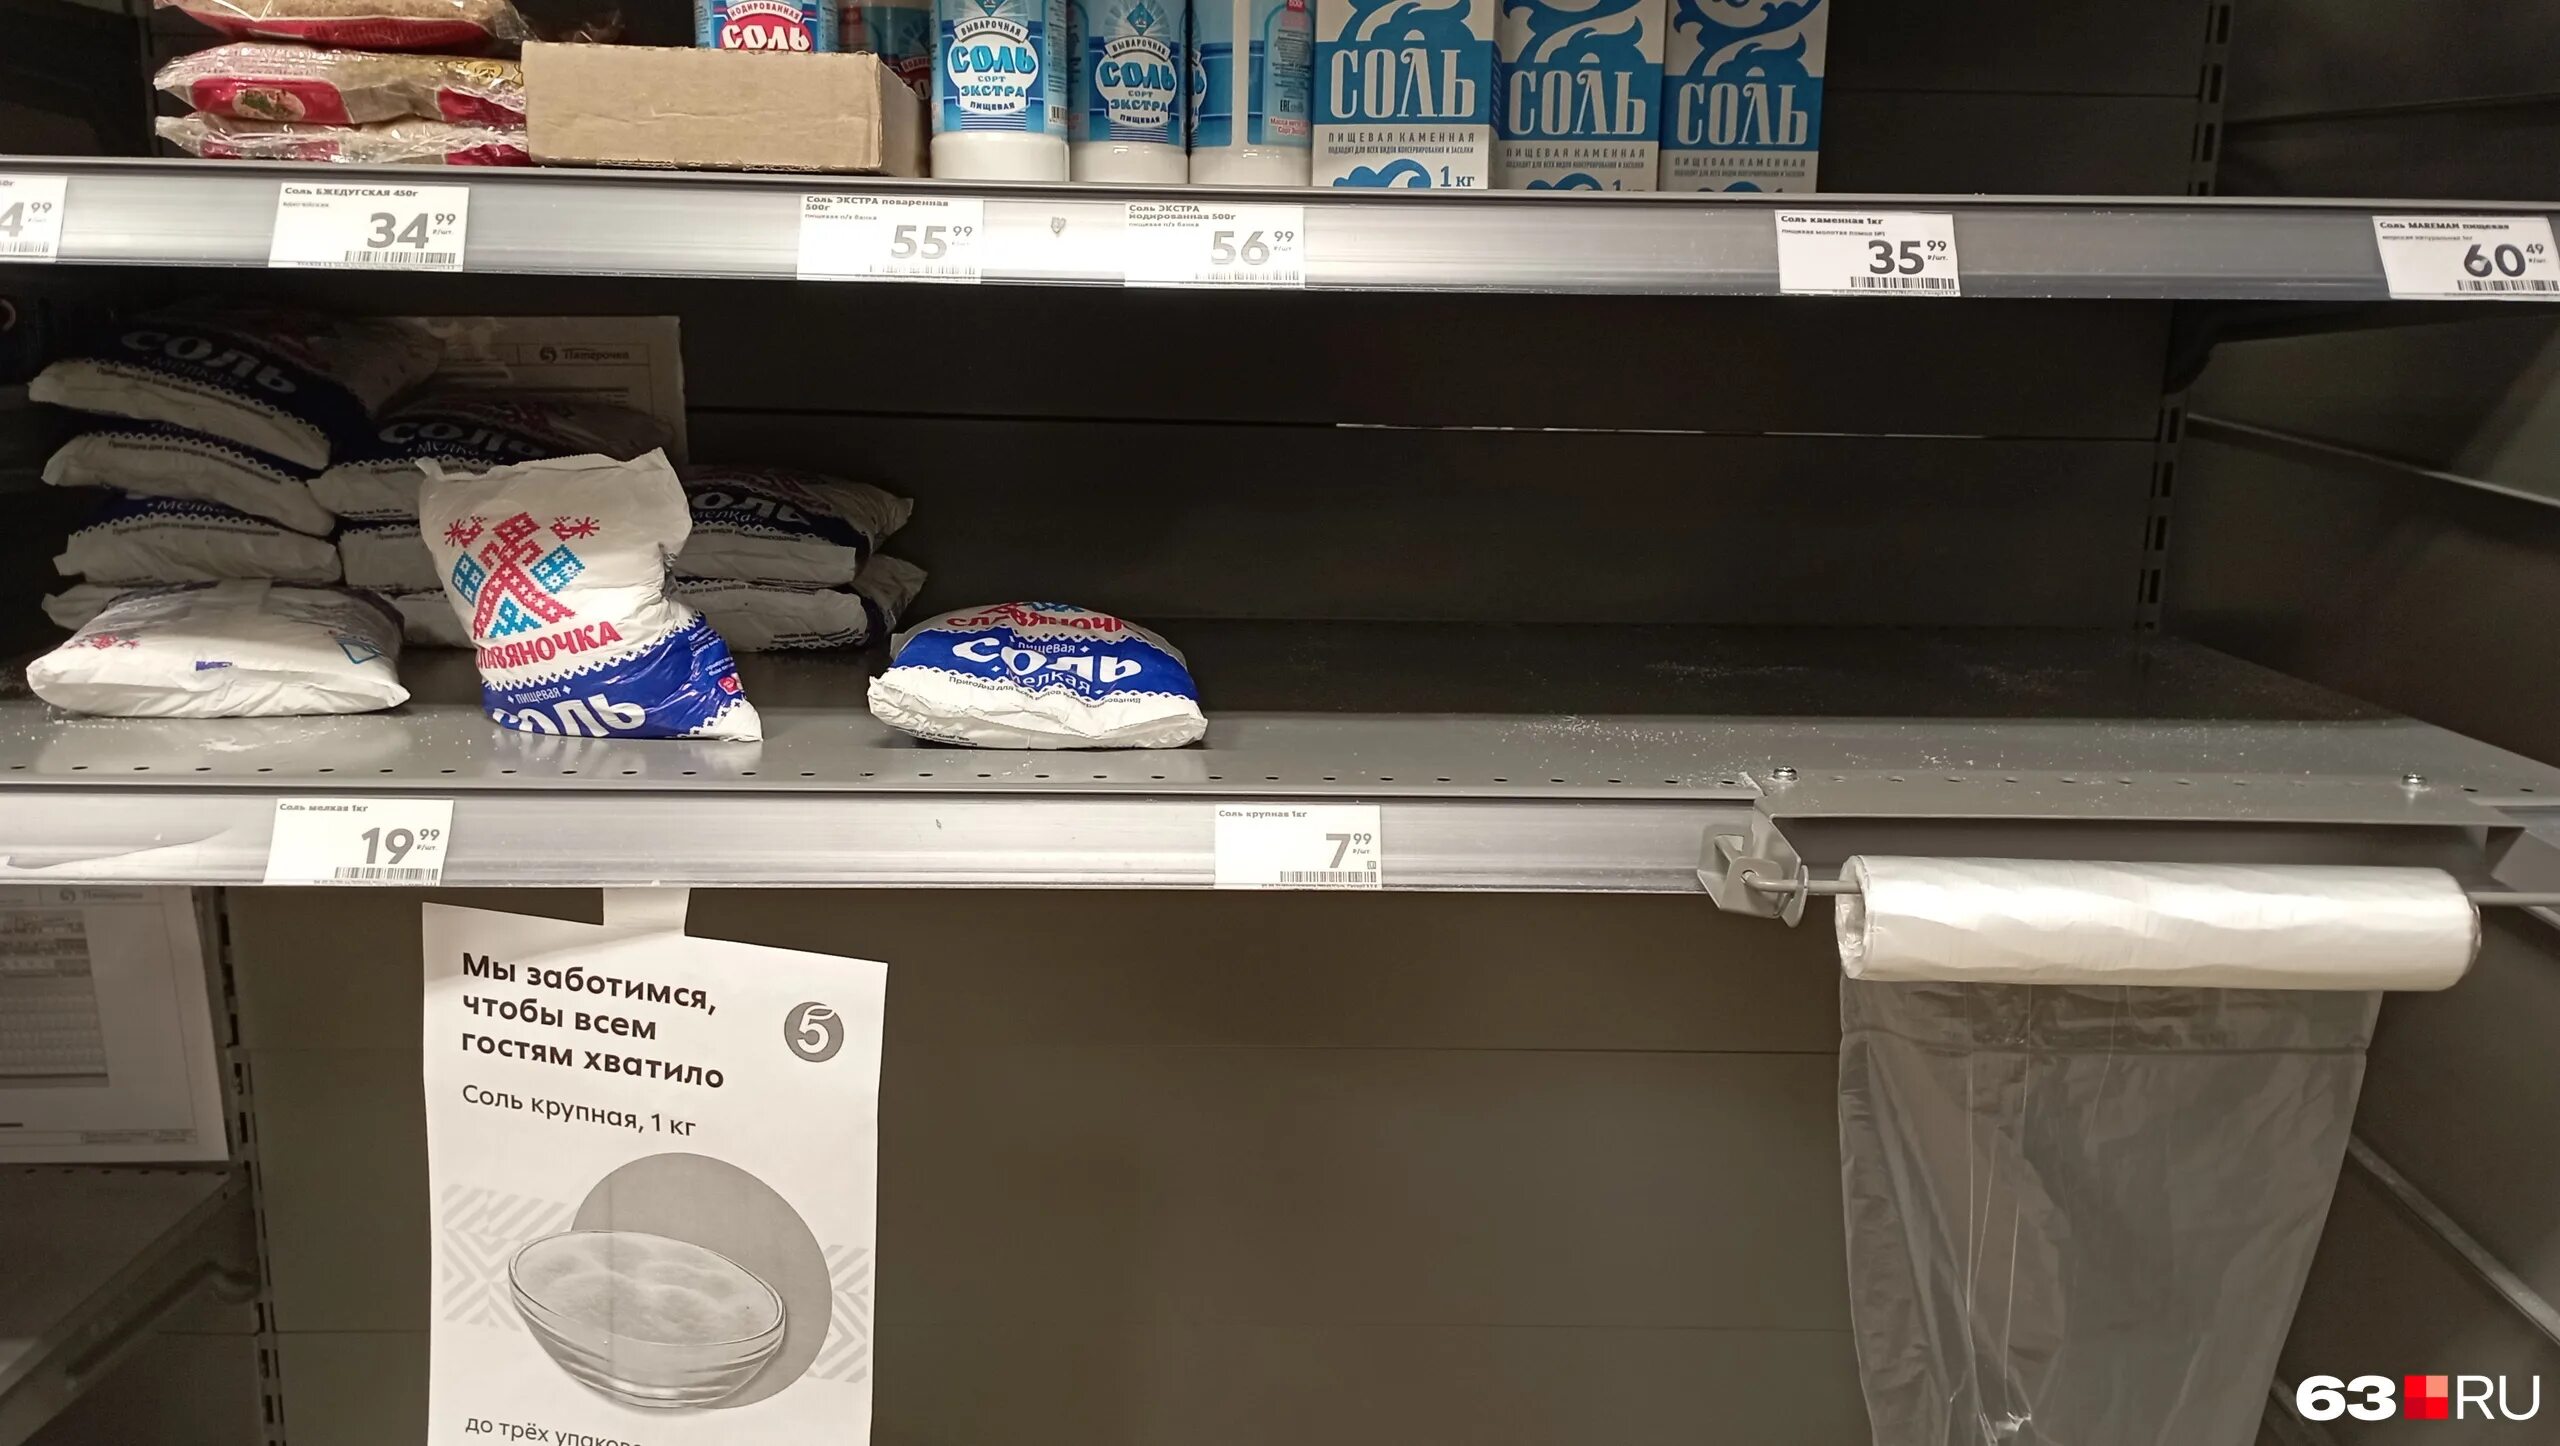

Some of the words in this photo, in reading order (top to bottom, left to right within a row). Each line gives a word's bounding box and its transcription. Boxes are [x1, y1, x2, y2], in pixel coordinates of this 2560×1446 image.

[722, 25, 811, 51] СОЛЬ
[961, 20, 1022, 37] ВЫВАРОЧНАЯ
[1112, 38, 1167, 55] ВЫВАРОЧНАЯ
[951, 45, 1036, 74] СОЛЬ
[1100, 61, 1176, 91] СОЛЬ
[1330, 47, 1476, 119] СОЛЬ
[961, 85, 1025, 97] ЭКСТРА
[1128, 90, 1154, 98] СОРТ
[1508, 69, 1646, 135] СОЛЬ
[970, 101, 1016, 111] ПИЩЕВАЯ
[1110, 99, 1168, 112] ЭКСТРА
[1677, 83, 1808, 145] СОЛЬ
[1119, 114, 1161, 124] ПИЩЕВАЯ
[1328, 132, 1393, 143] ПИЩЕВАЯ
[1400, 132, 1475, 143] КАМЕННАЯ
[1506, 147, 1569, 158] ПИЩЕВАЯ
[1574, 147, 1645, 158] КАМЕННАЯ
[1675, 157, 1734, 168] ПИЩЕВАЯ
[1739, 157, 1806, 168] КАМЕННАЯ
[1440, 165, 1451, 187] 1
[1456, 175, 1475, 187] кг
[284, 187, 312, 195] Соль
[316, 188, 390, 197] БЖЕДУГСКАЯ
[393, 189, 418, 197] 450г
[806, 195, 834, 204] Соль
[836, 196, 879, 205] ЭКСТРА
[881, 198, 949, 207] поваренная
[31, 202, 52, 213] 99
[1129, 204, 1156, 212] Соль
[1158, 204, 1200, 213] ЭКСТРА
[1212, 213, 1237, 221] 500г
[367, 212, 430, 249] 34
[435, 213, 456, 226] 99
[1781, 215, 1807, 223] Соль
[1810, 216, 1864, 224] каменная
[1866, 217, 1884, 226] 1кг
[2379, 221, 2406, 229] Соль
[890, 224, 948, 260] 55
[953, 225, 973, 237] 99
[1211, 230, 1270, 266] 56
[1274, 230, 1294, 242] 99
[1868, 239, 1925, 275] 35
[1926, 240, 1947, 252] 99
[2463, 243, 2526, 278] 60
[2526, 243, 2544, 255] 49
[120, 329, 297, 395] СОЛЬ
[691, 490, 812, 526] ОЛЬ
[952, 637, 1142, 683] СОЛЬ
[515, 687, 561, 705] пищевая
[996, 683, 1014, 691] для
[279, 803, 306, 811] Соль
[308, 804, 349, 812] мелкая
[351, 804, 369, 812] 1кг
[1246, 811, 1290, 819] крупная
[1291, 810, 1308, 818] 1кг
[361, 827, 415, 865] 19
[419, 828, 440, 840] 99
[1326, 833, 1351, 869] 7
[1353, 833, 1372, 845] 99
[462, 952, 517, 983] Мы
[527, 966, 717, 1016] заботимся,
[463, 994, 563, 1028] чтобы
[574, 1012, 657, 1040] всем
[462, 1032, 573, 1068] гостям
[583, 1050, 724, 1088] хватило
[462, 1084, 523, 1111] Соль
[531, 1097, 645, 1133] крупная,
[650, 1113, 661, 1132] 1
[669, 1117, 697, 1137] кг
[465, 1417, 493, 1434] до
[498, 1422, 550, 1442] трёх
[555, 1431, 642, 1446] упако
